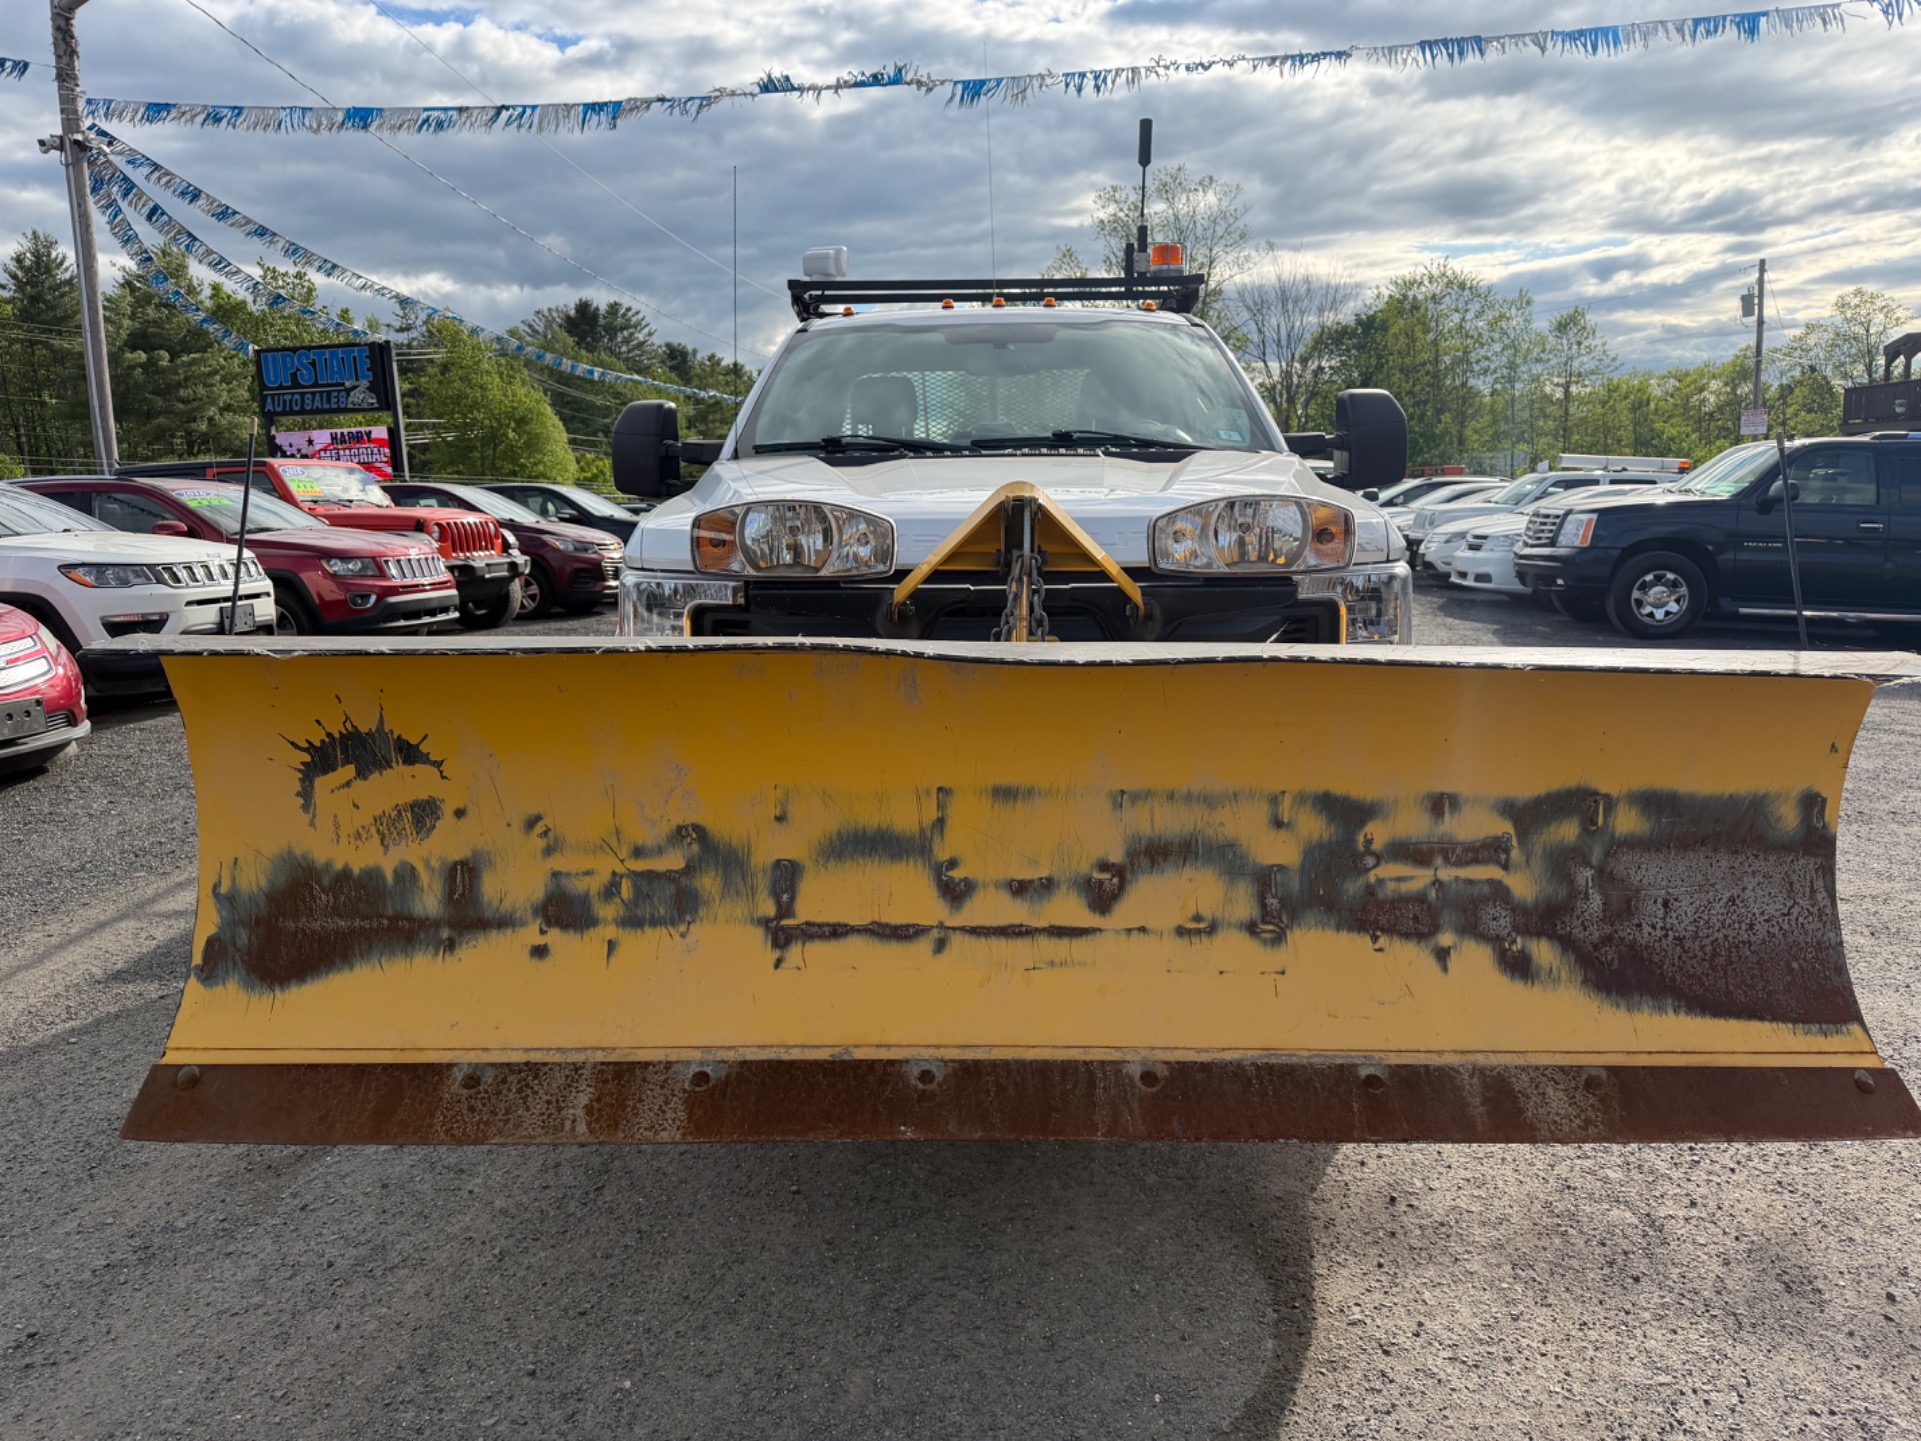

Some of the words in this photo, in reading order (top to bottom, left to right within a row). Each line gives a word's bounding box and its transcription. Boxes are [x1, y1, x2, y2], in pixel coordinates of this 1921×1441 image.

[261, 346, 373, 387] UPSTATE
[264, 394, 301, 413] AUTO
[304, 391, 347, 409] SALES
[330, 430, 372, 446] HAPPY
[319, 446, 391, 464] MEMORIAL
